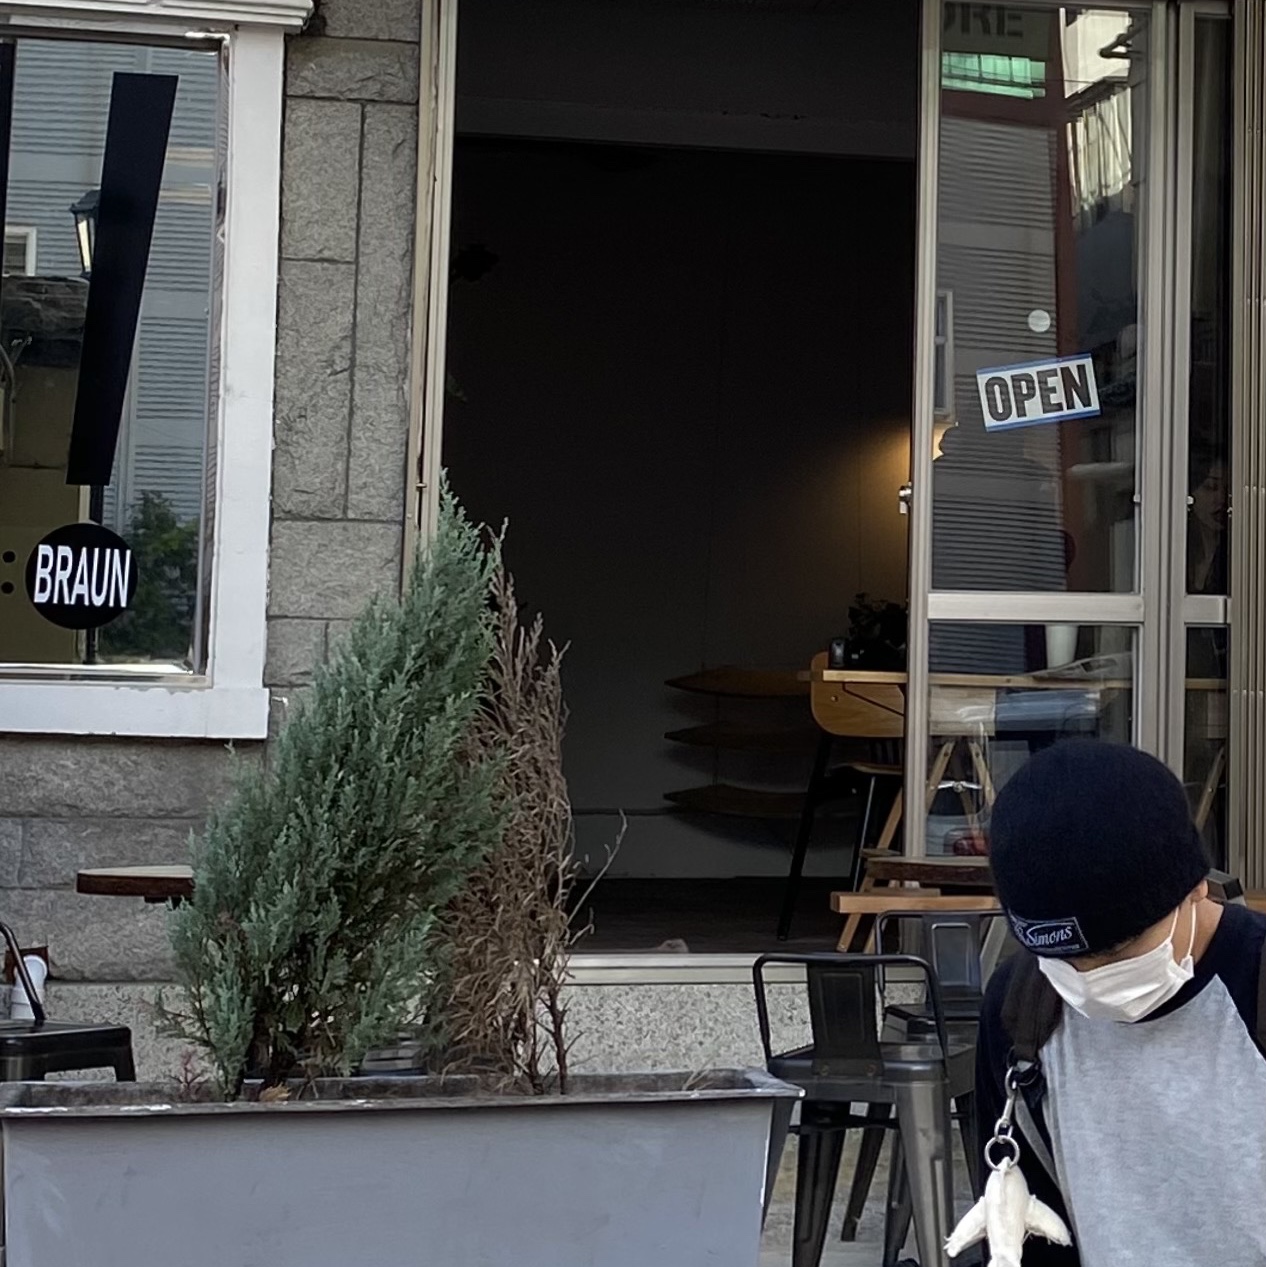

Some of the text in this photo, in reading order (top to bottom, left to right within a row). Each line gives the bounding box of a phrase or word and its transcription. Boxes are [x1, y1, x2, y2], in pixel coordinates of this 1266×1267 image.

[985, 364, 1092, 421] OPEN
[33, 544, 131, 608] BRAUN
[1026, 922, 1075, 946] Simons
